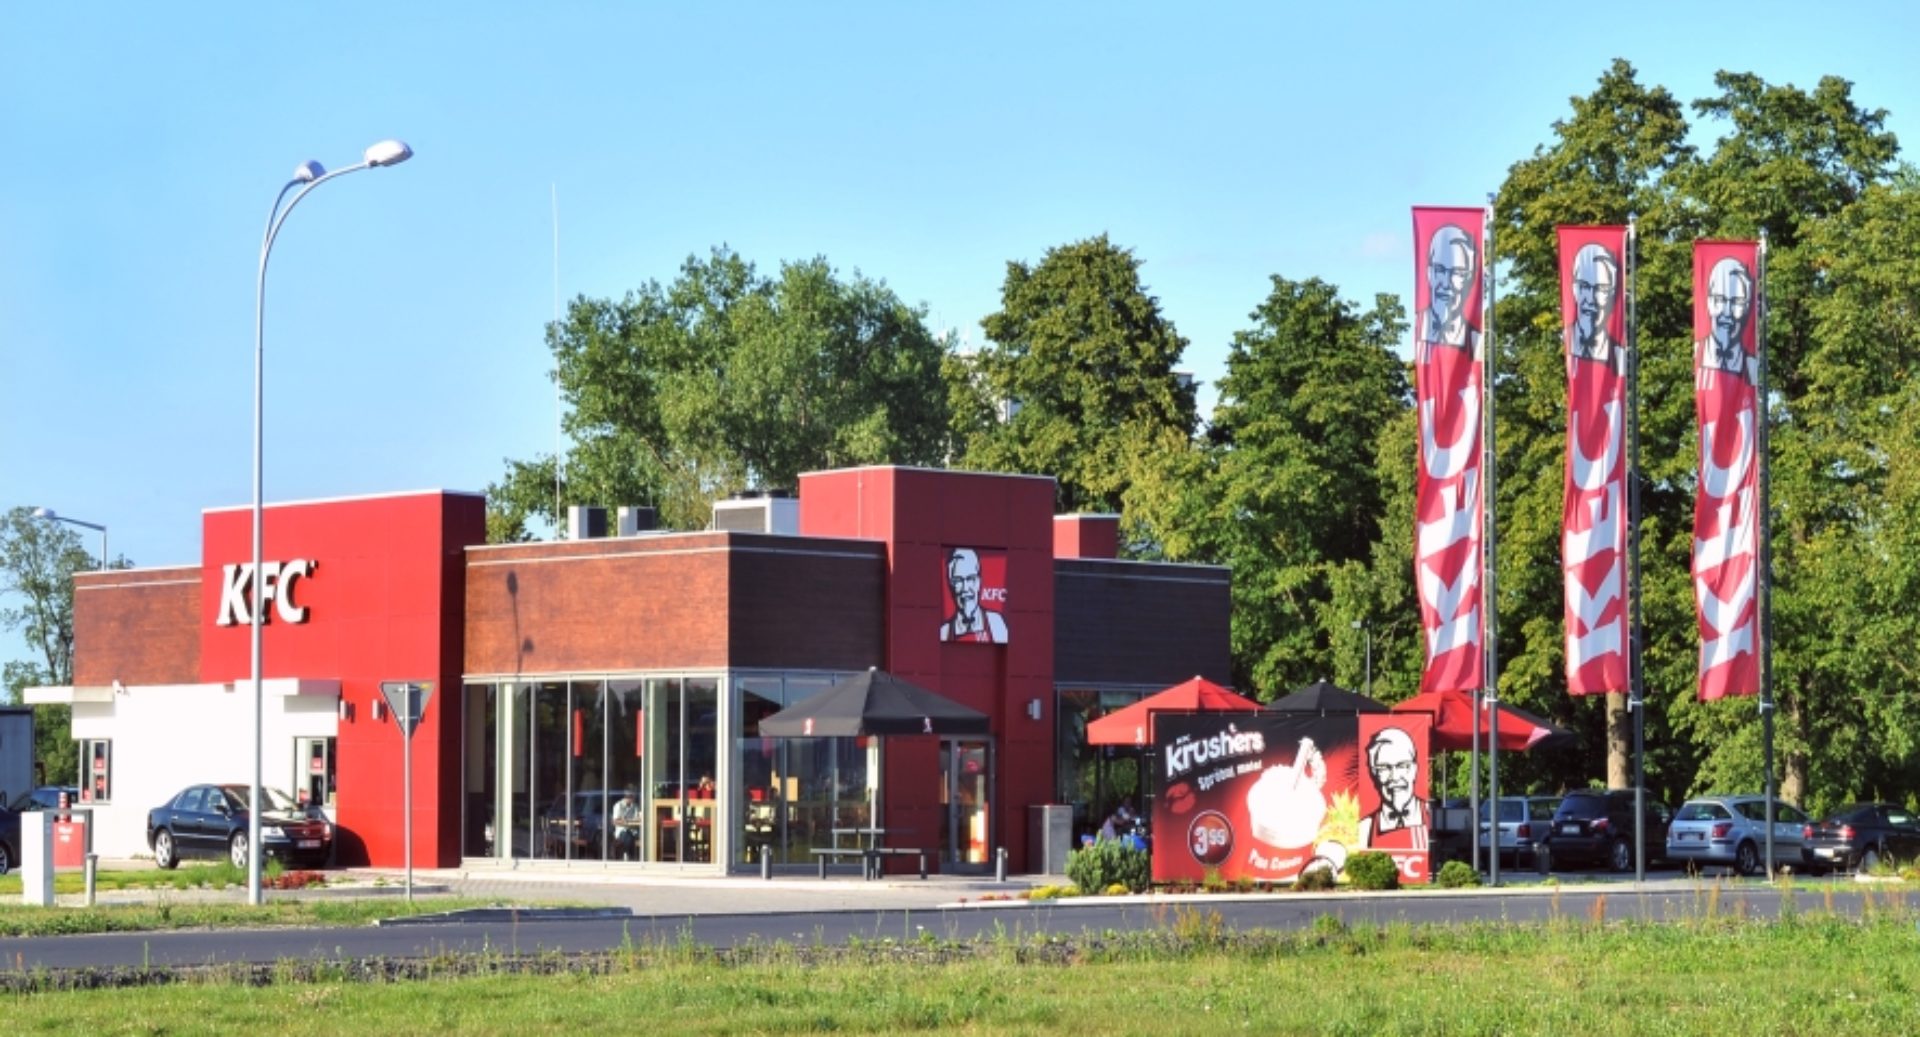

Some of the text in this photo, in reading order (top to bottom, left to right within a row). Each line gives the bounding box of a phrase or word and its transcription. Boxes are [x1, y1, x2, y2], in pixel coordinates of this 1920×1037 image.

[216, 559, 306, 625] KFC
[981, 587, 1007, 602] KFC
[1392, 855, 1423, 878] FC
